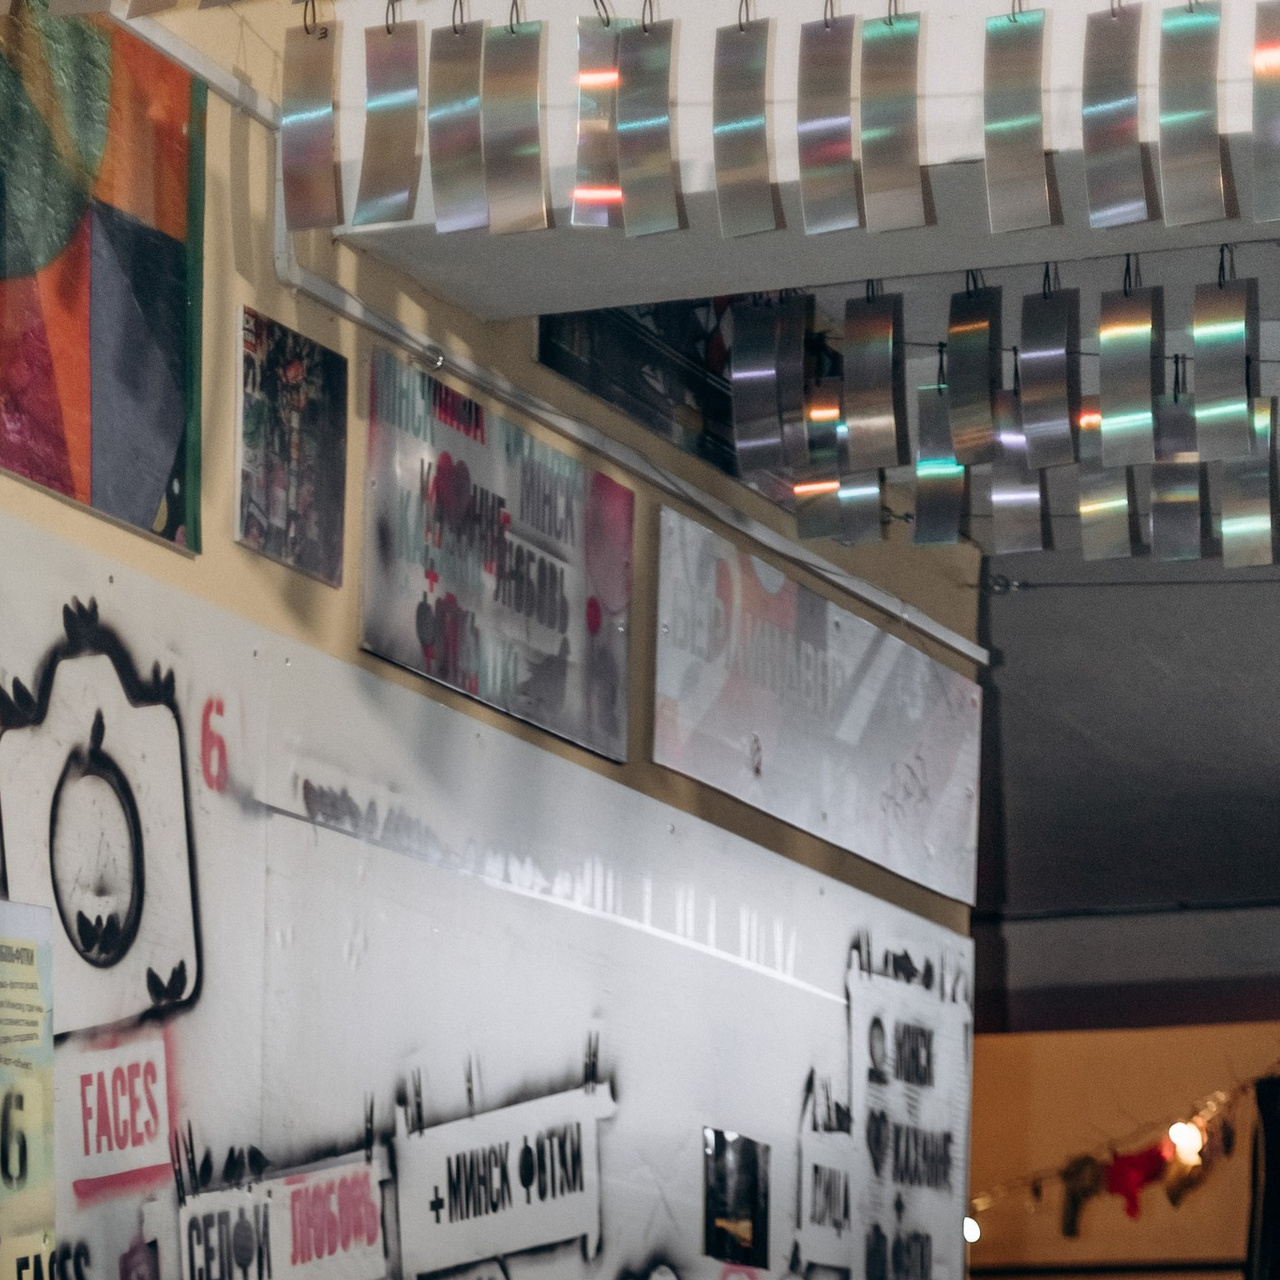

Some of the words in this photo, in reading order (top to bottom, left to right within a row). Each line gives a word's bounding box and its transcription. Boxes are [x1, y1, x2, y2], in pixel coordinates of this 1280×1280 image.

[201, 698, 228, 792] 6
[80, 1059, 159, 1157] FACES
[447, 1142, 512, 1223] МИНСК
